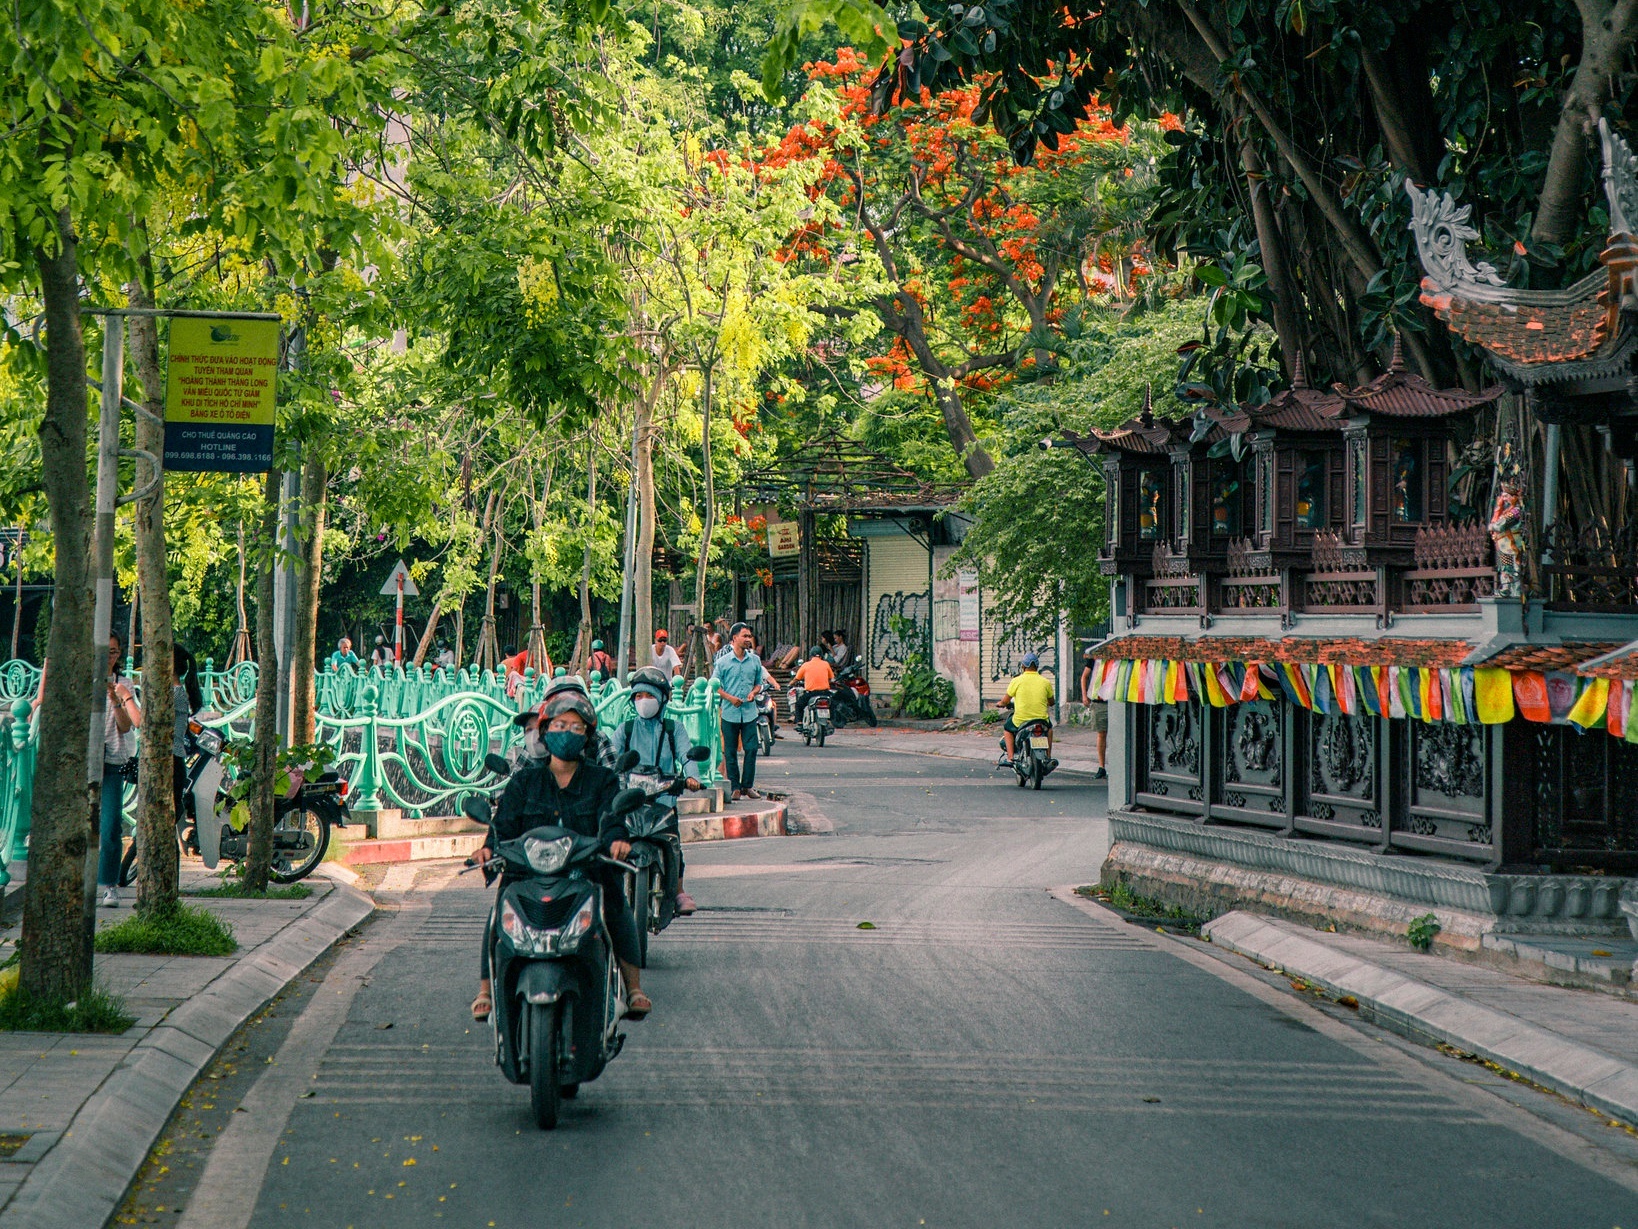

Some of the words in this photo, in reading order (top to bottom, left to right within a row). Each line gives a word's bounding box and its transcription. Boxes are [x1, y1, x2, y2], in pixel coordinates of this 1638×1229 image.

[217, 367, 234, 375] THAM
[235, 368, 253, 376] QUAN
[250, 379, 268, 387] LONG
[182, 431, 197, 439] CHO
